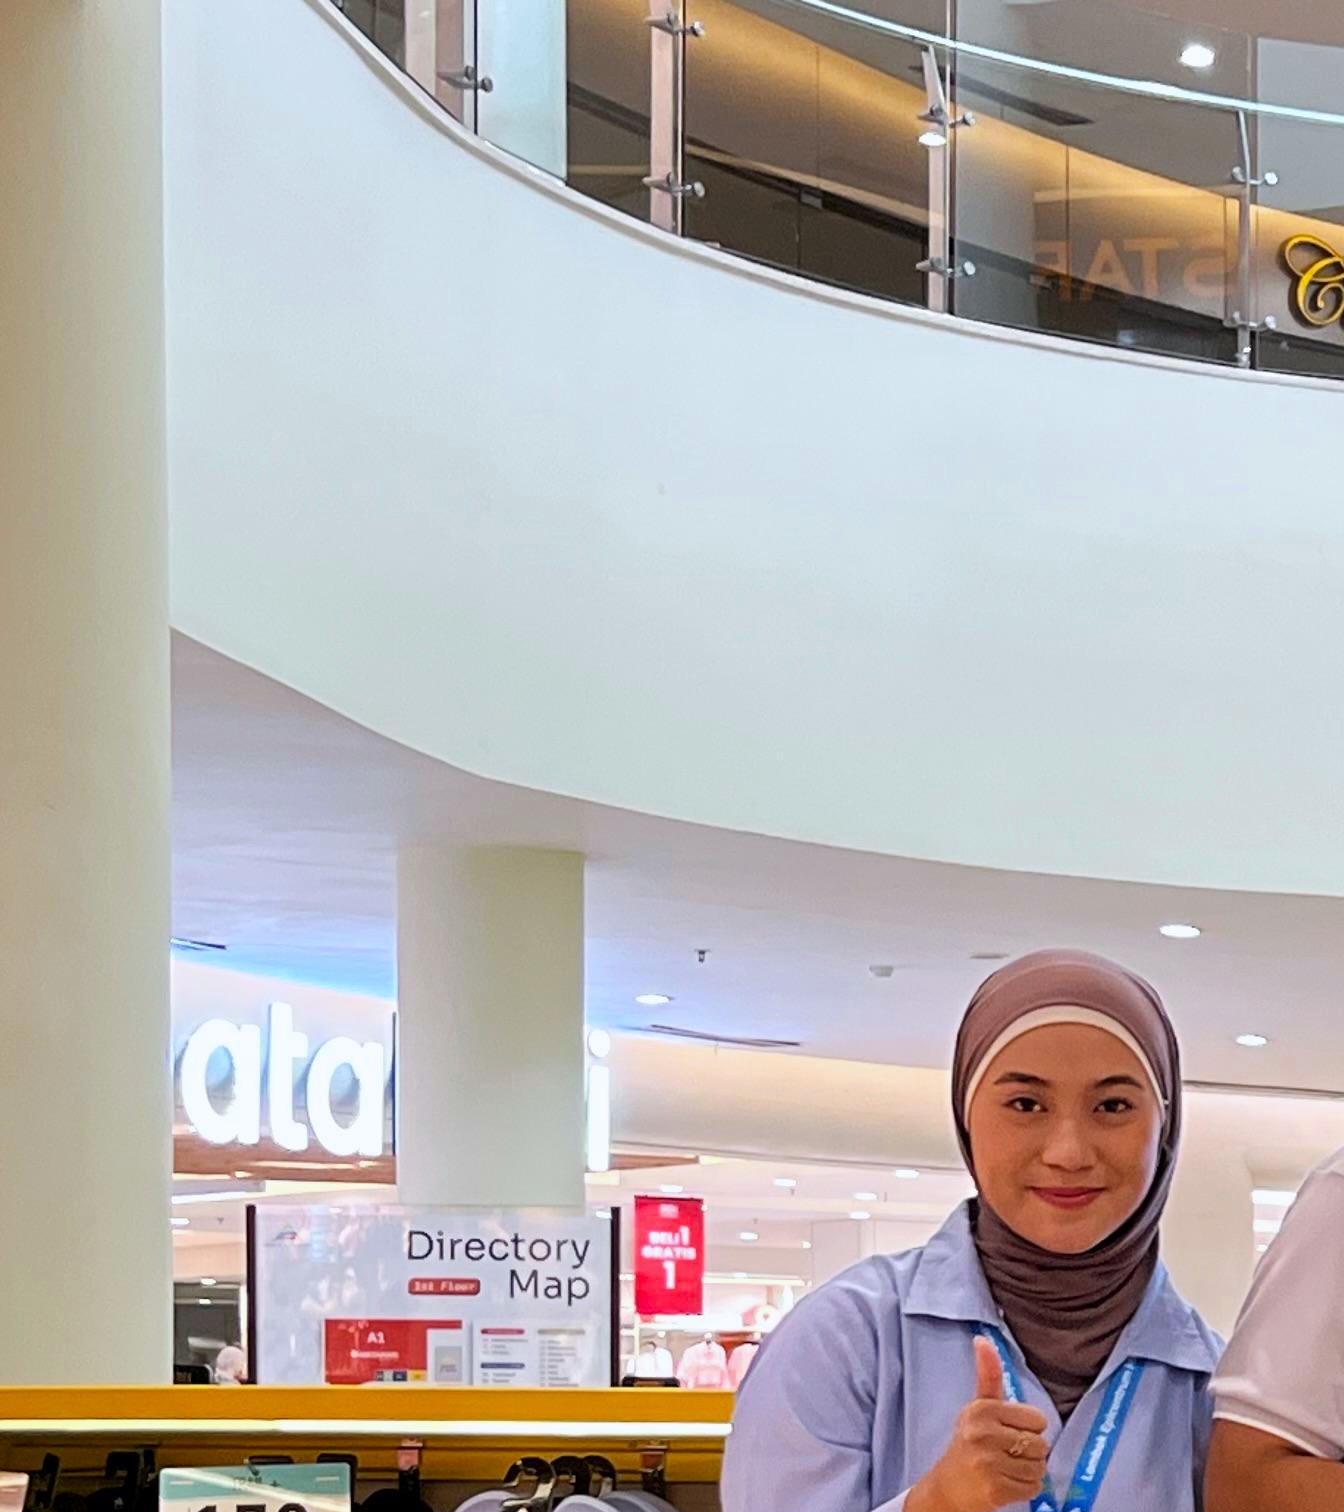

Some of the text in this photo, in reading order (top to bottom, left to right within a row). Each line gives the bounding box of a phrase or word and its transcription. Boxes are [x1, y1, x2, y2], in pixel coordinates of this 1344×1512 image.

[407, 1230, 590, 1269] Directory
[509, 1269, 590, 1306] Map
[663, 1260, 676, 1290] 1
